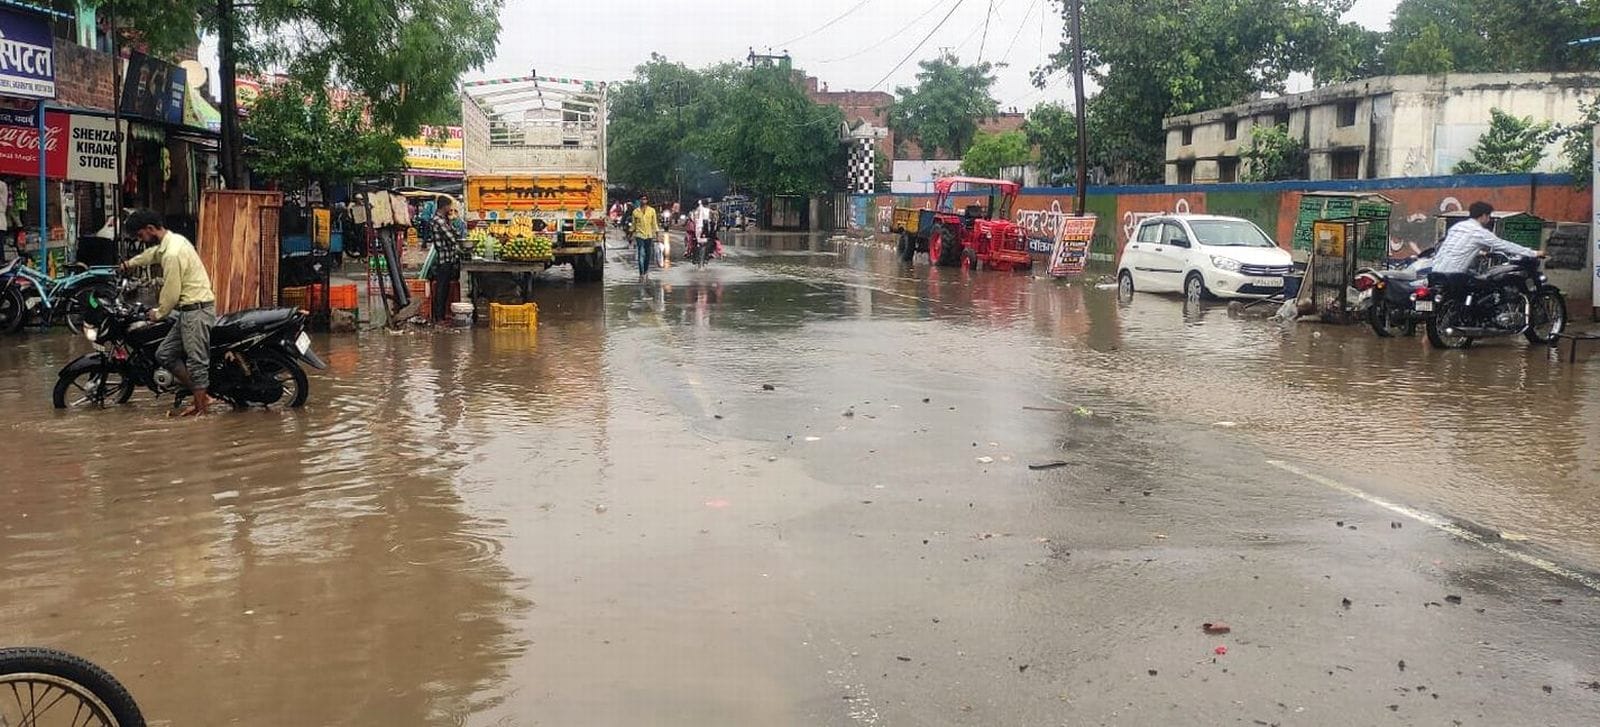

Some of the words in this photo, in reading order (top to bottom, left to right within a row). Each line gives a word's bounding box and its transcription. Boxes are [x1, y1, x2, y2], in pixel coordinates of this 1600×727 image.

[73, 127, 125, 143] SHEHZAD
[77, 141, 120, 156] KIRANA
[79, 155, 116, 170] STORE
[514, 187, 556, 198] TATA
